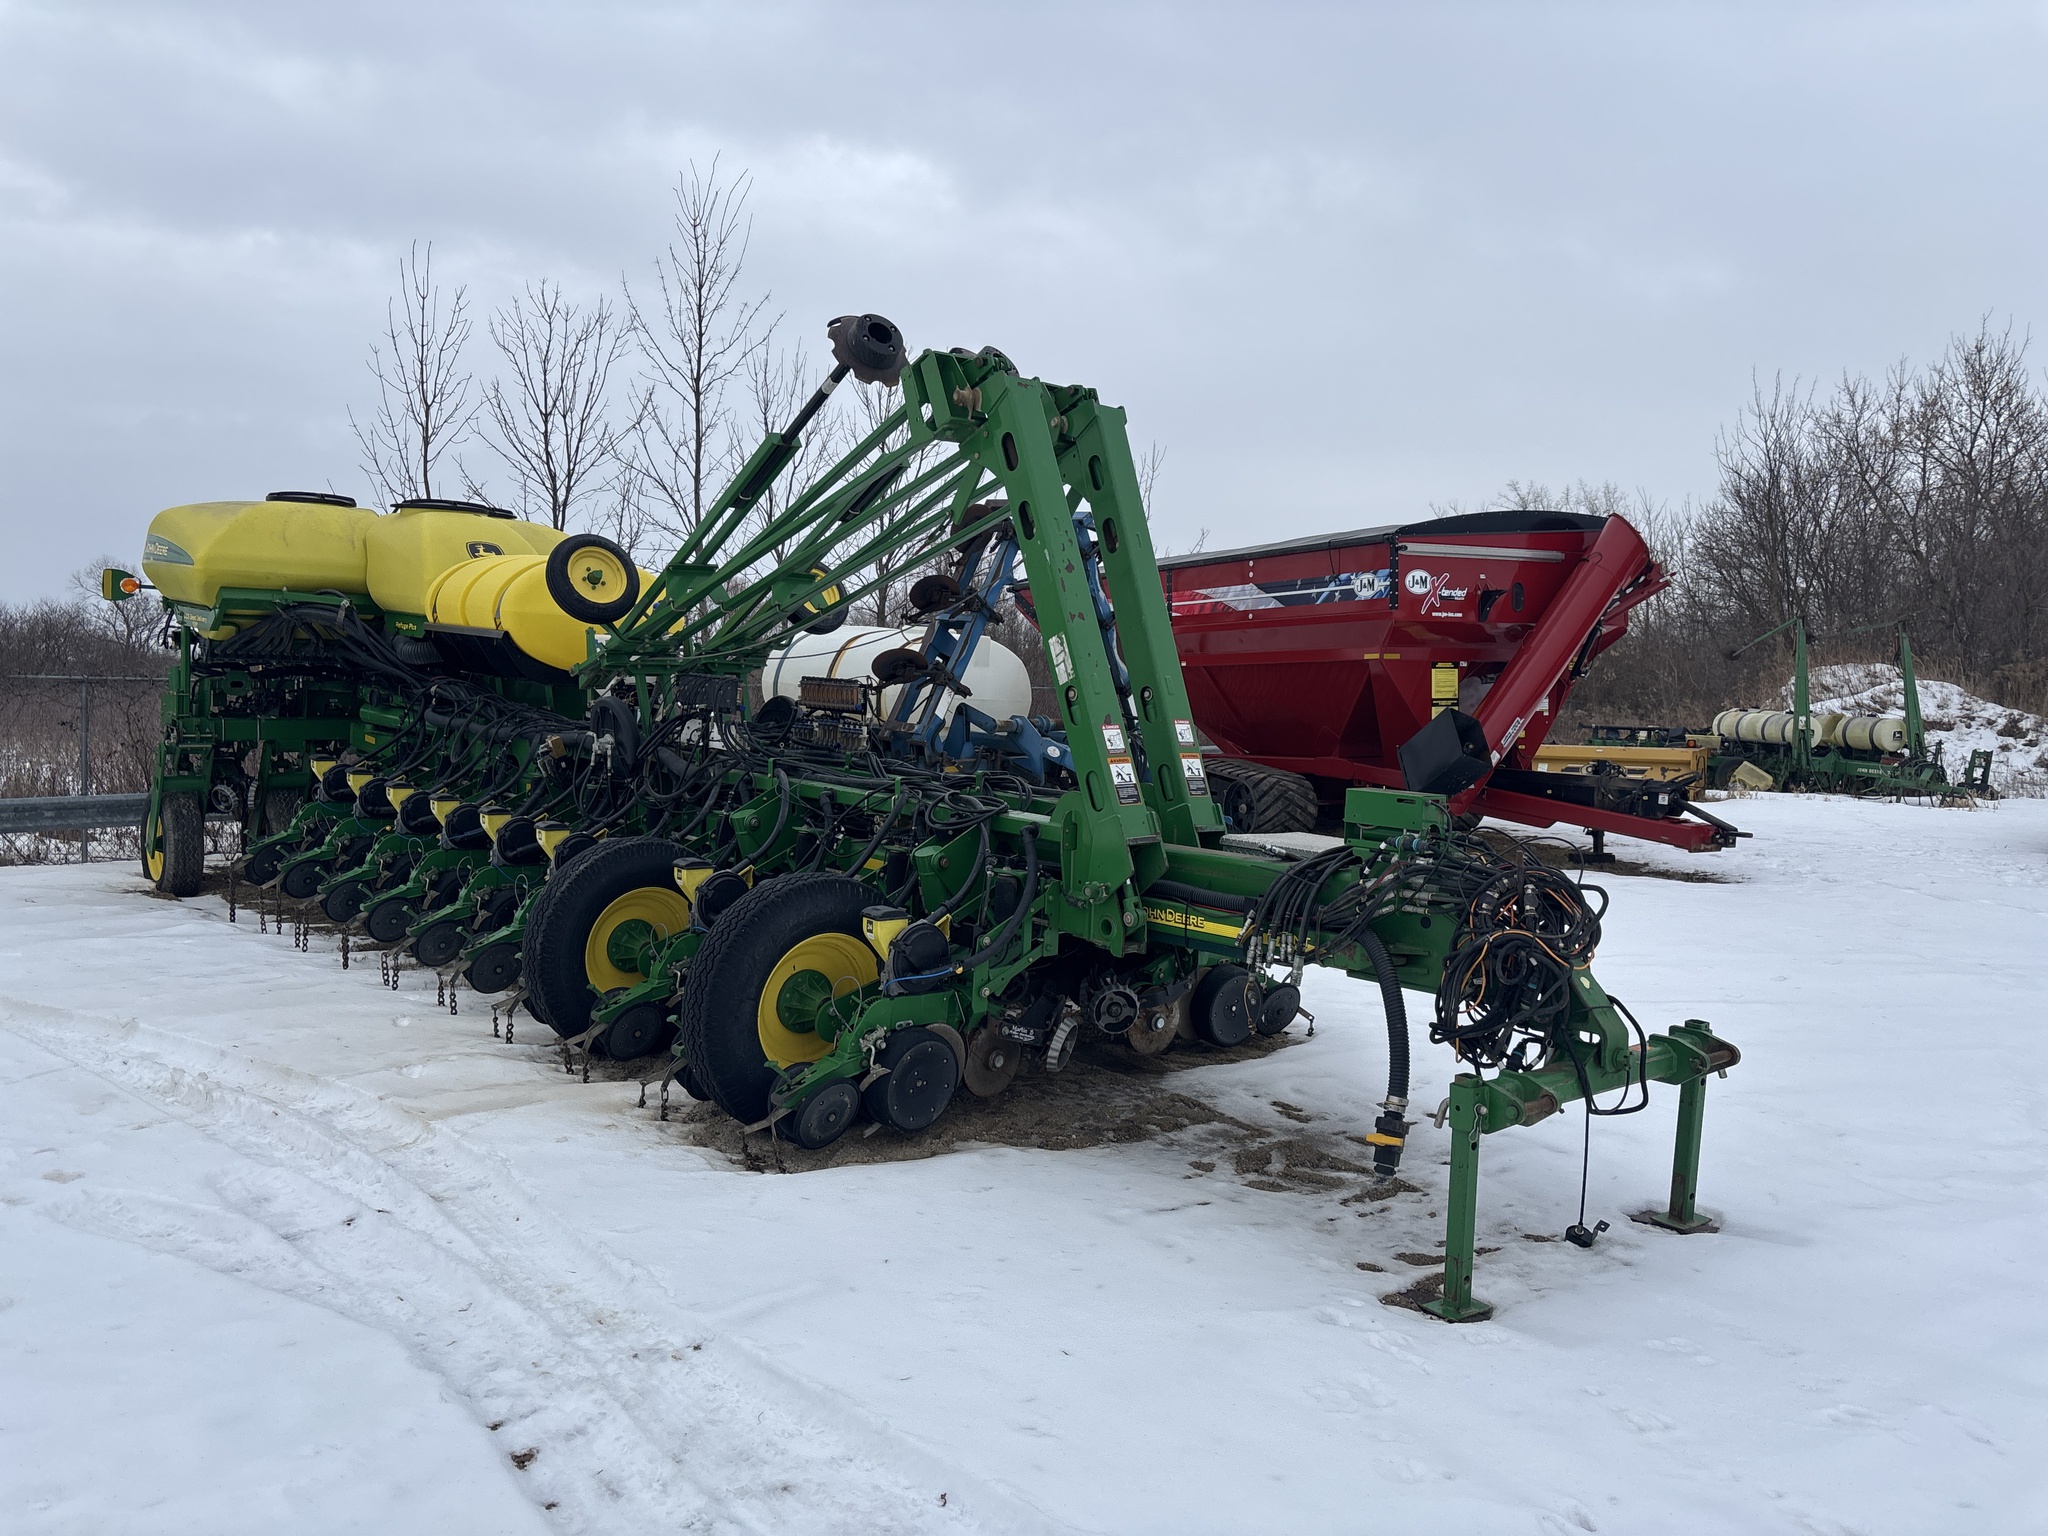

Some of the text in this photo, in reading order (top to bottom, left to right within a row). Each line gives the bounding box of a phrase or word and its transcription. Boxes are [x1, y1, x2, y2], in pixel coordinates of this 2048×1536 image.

[154, 542, 169, 556] DEERE
[1356, 578, 1375, 593] J&M
[1408, 575, 1428, 589] J&M
[1142, 906, 1205, 928] OHN DEERE
